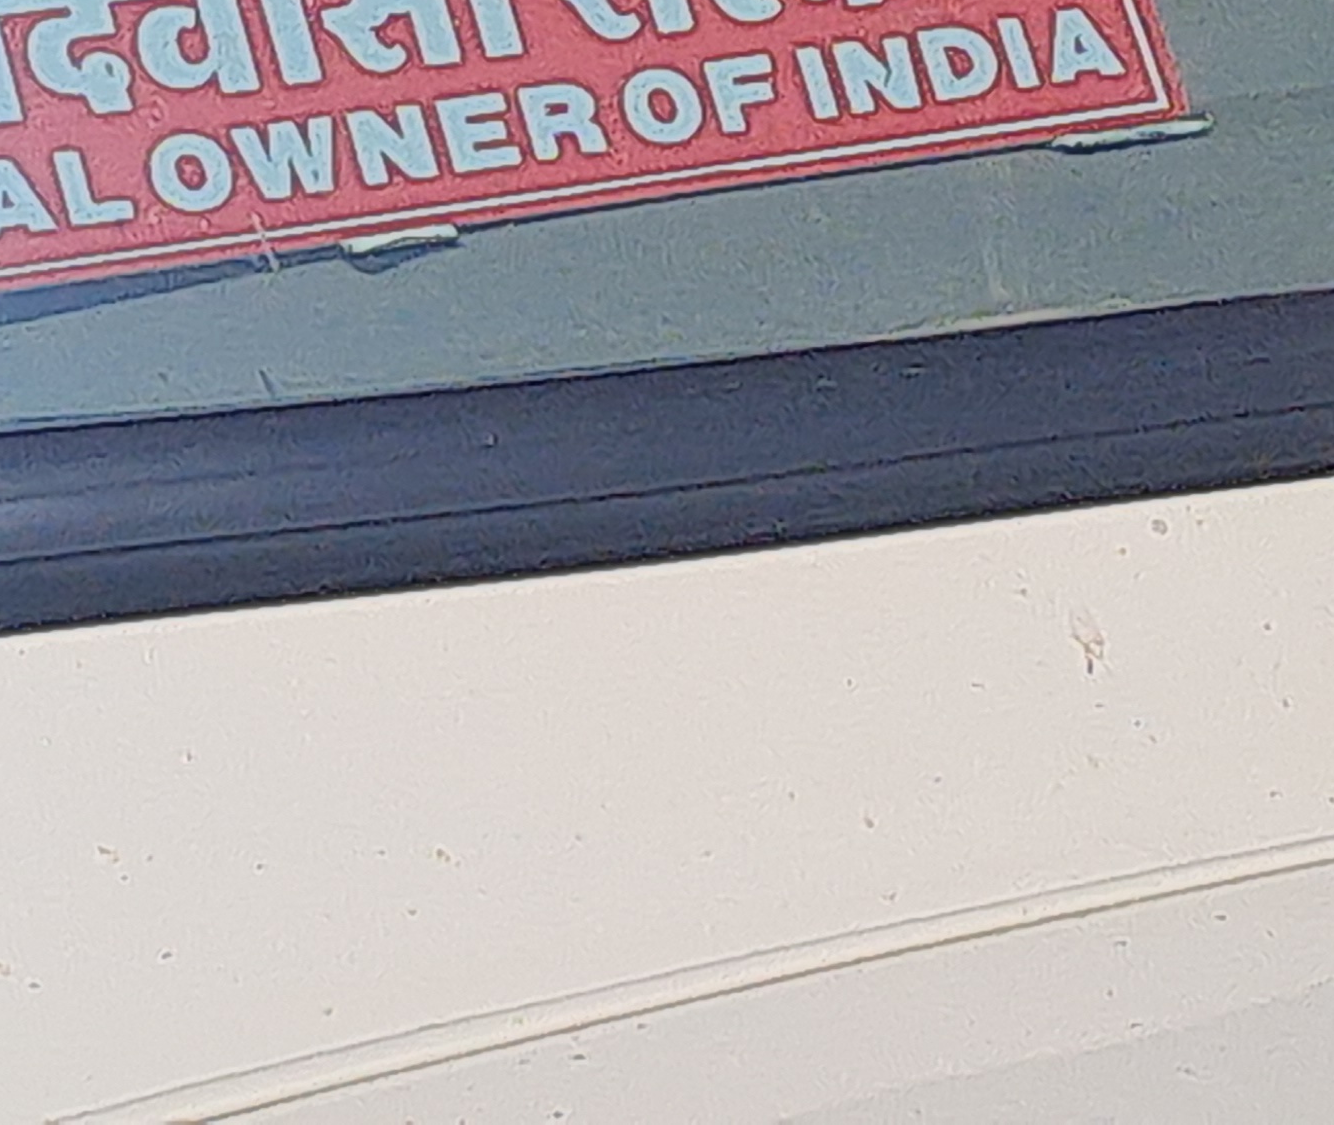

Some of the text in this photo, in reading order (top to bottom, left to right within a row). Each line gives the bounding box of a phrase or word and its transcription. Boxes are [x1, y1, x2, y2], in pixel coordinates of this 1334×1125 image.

[150, 83, 607, 213] OWNER
[623, 53, 774, 143] OF
[798, 10, 1124, 120] INDIA
